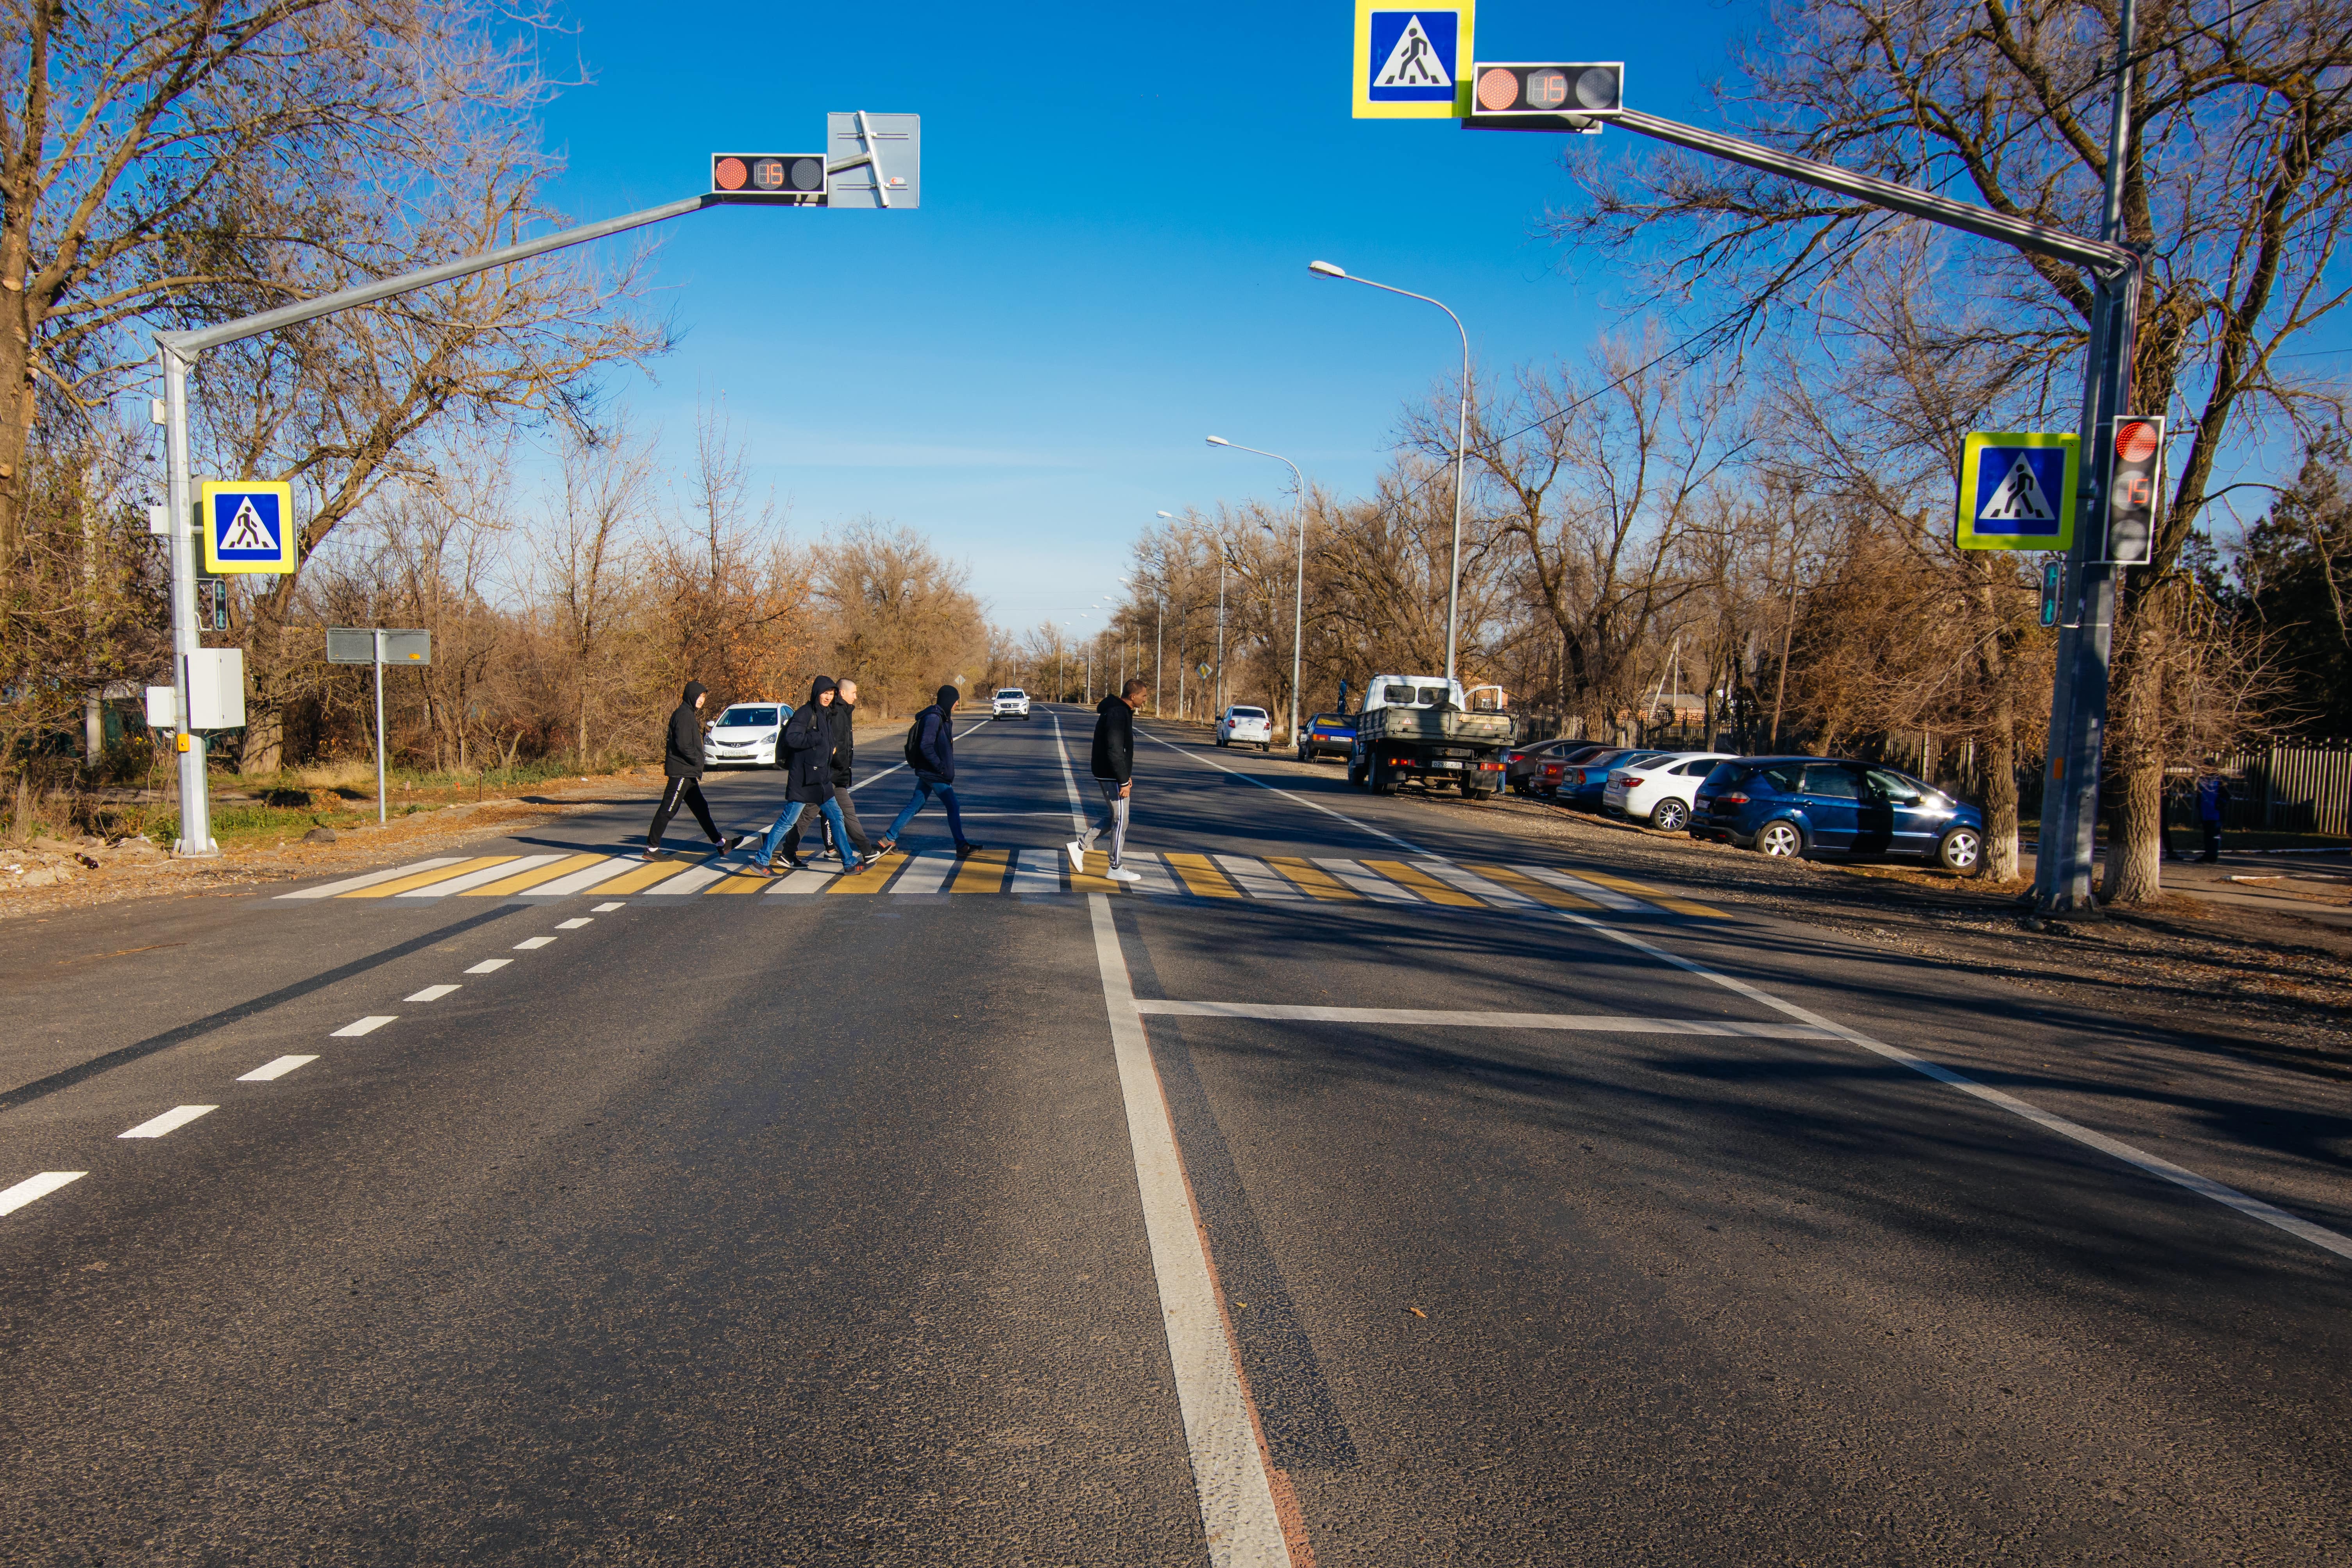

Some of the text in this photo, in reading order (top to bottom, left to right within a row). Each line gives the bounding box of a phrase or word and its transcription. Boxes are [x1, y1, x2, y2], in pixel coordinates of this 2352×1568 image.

[1544, 76, 1564, 102] 15
[766, 163, 783, 184] 15
[2128, 478, 2148, 503] 15
